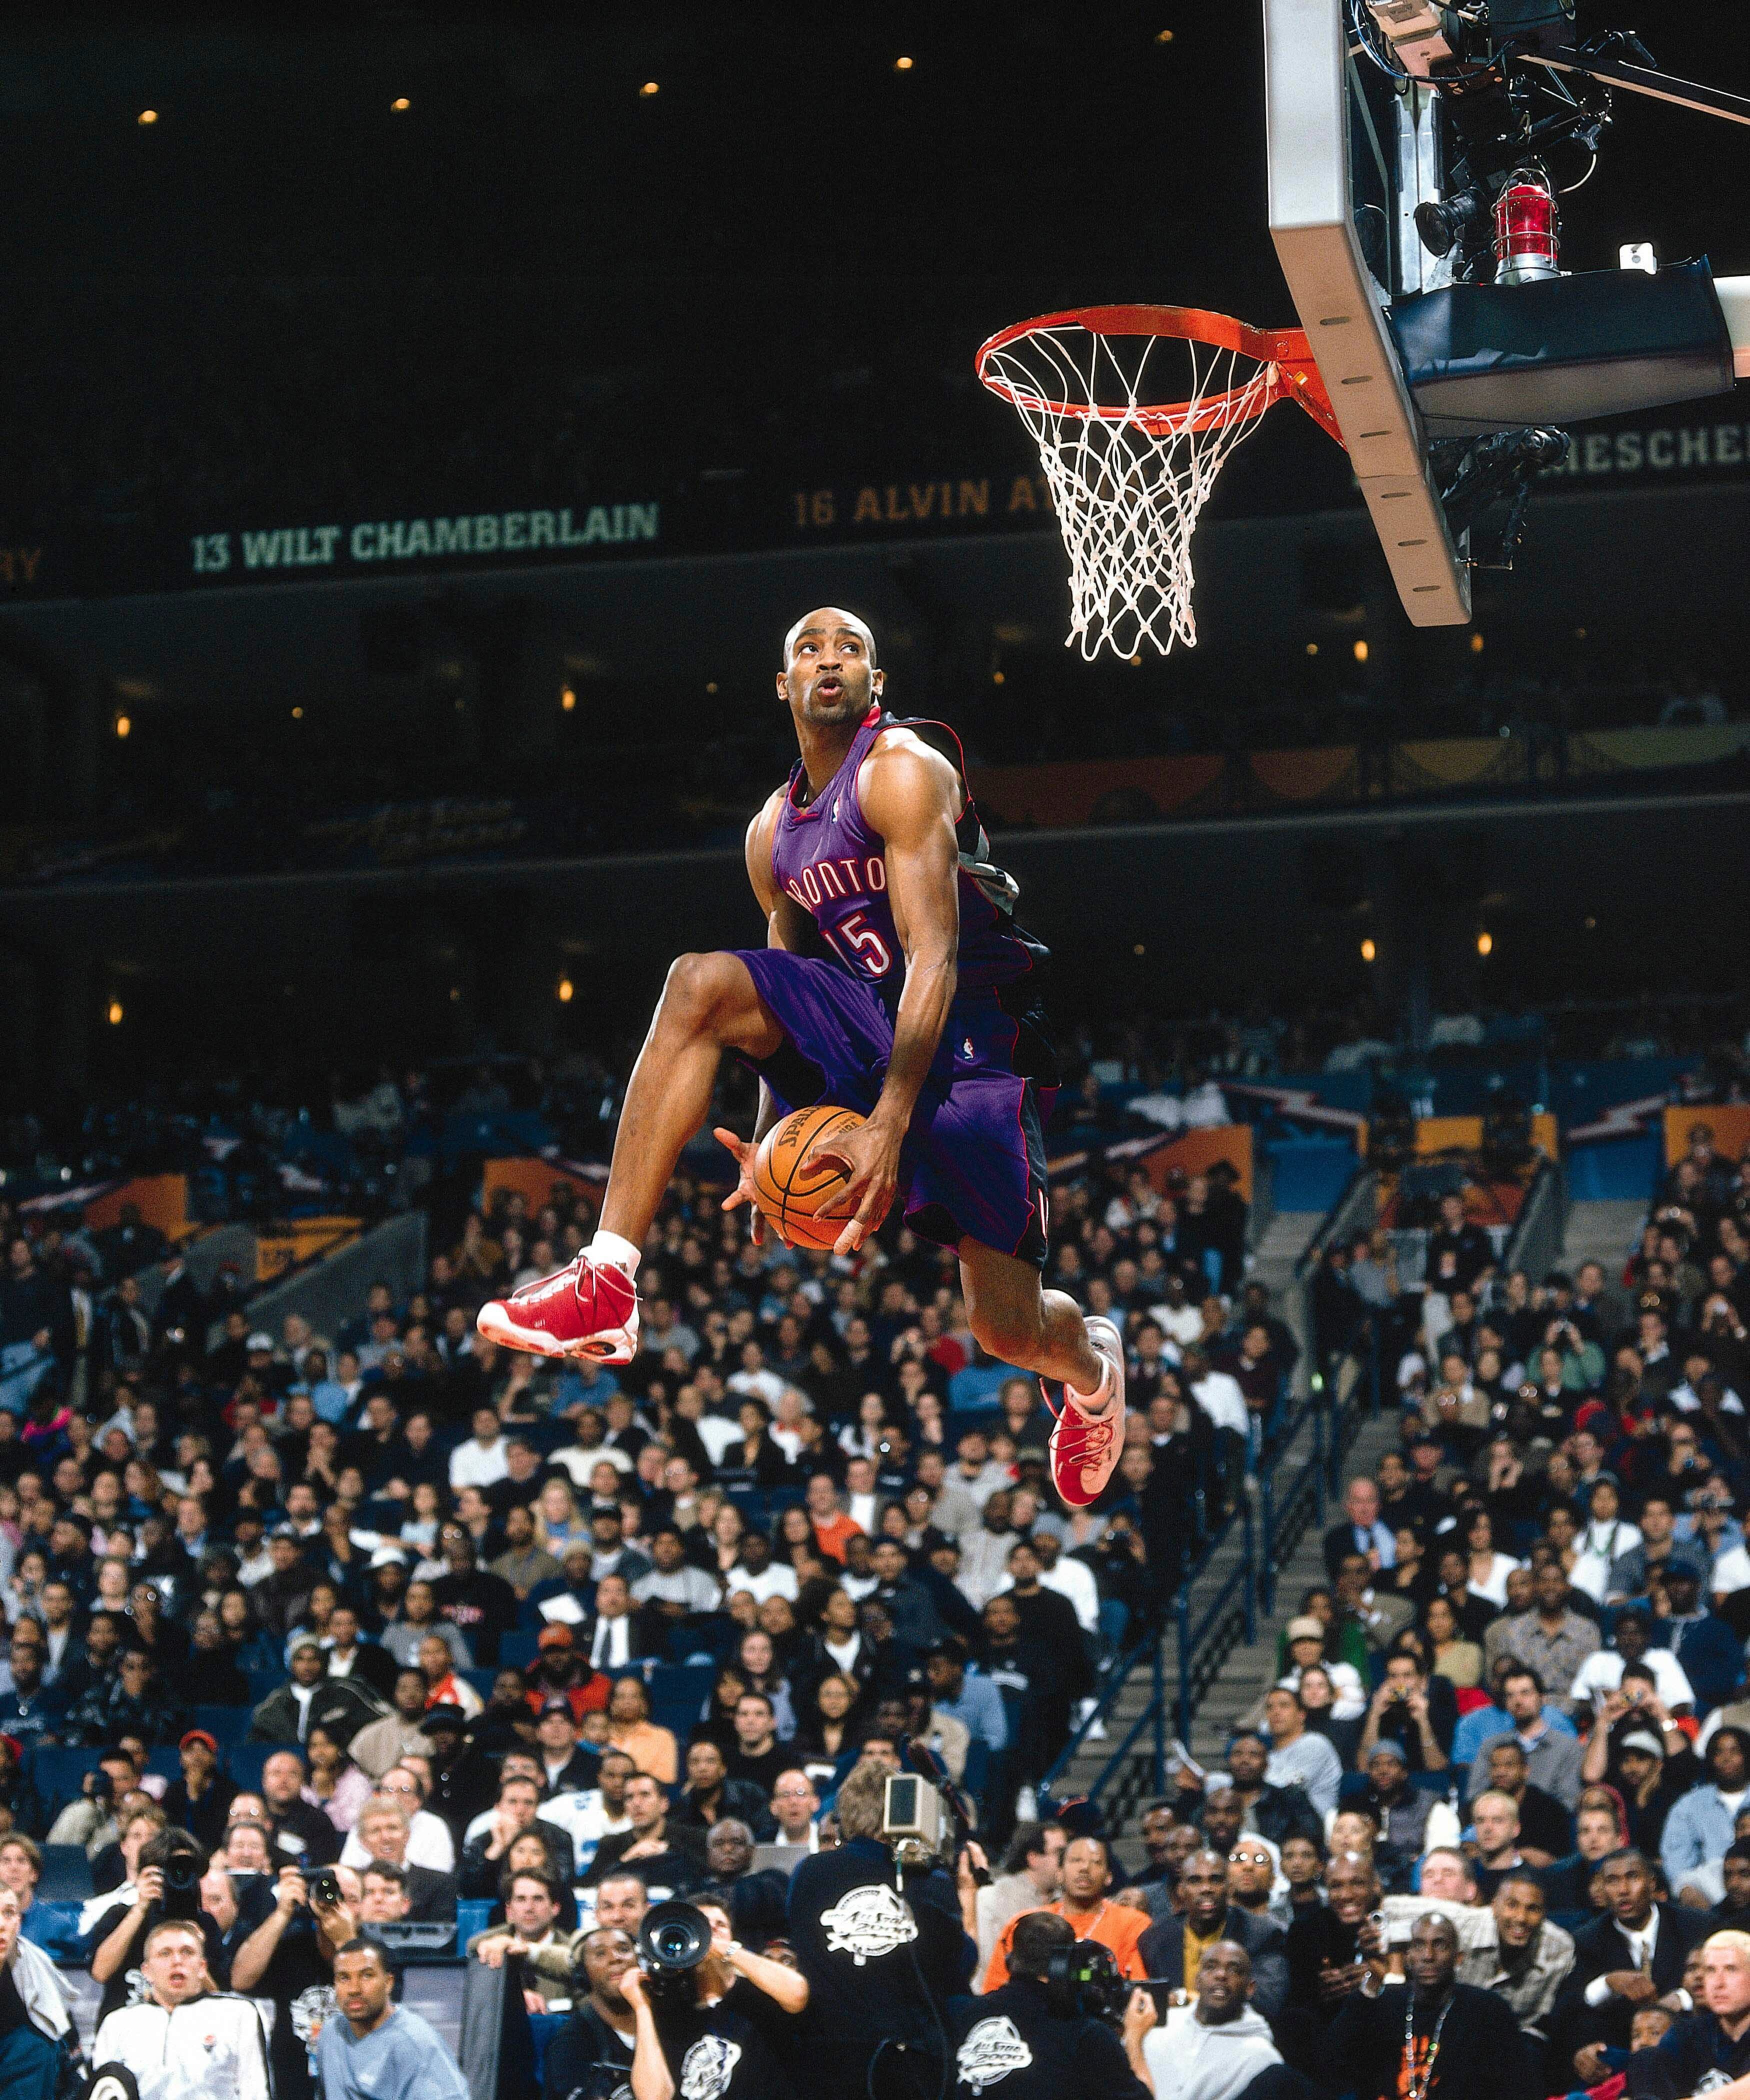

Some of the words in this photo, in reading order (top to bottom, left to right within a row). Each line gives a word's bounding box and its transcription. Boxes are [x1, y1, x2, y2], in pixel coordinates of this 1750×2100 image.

[794, 490, 836, 526] 16
[853, 478, 990, 523] ALVIN
[192, 532, 230, 574] 13
[242, 525, 341, 570] WILT
[350, 503, 660, 561] CHAMBERLAIN
[976, 2054, 1024, 2064] 2000
